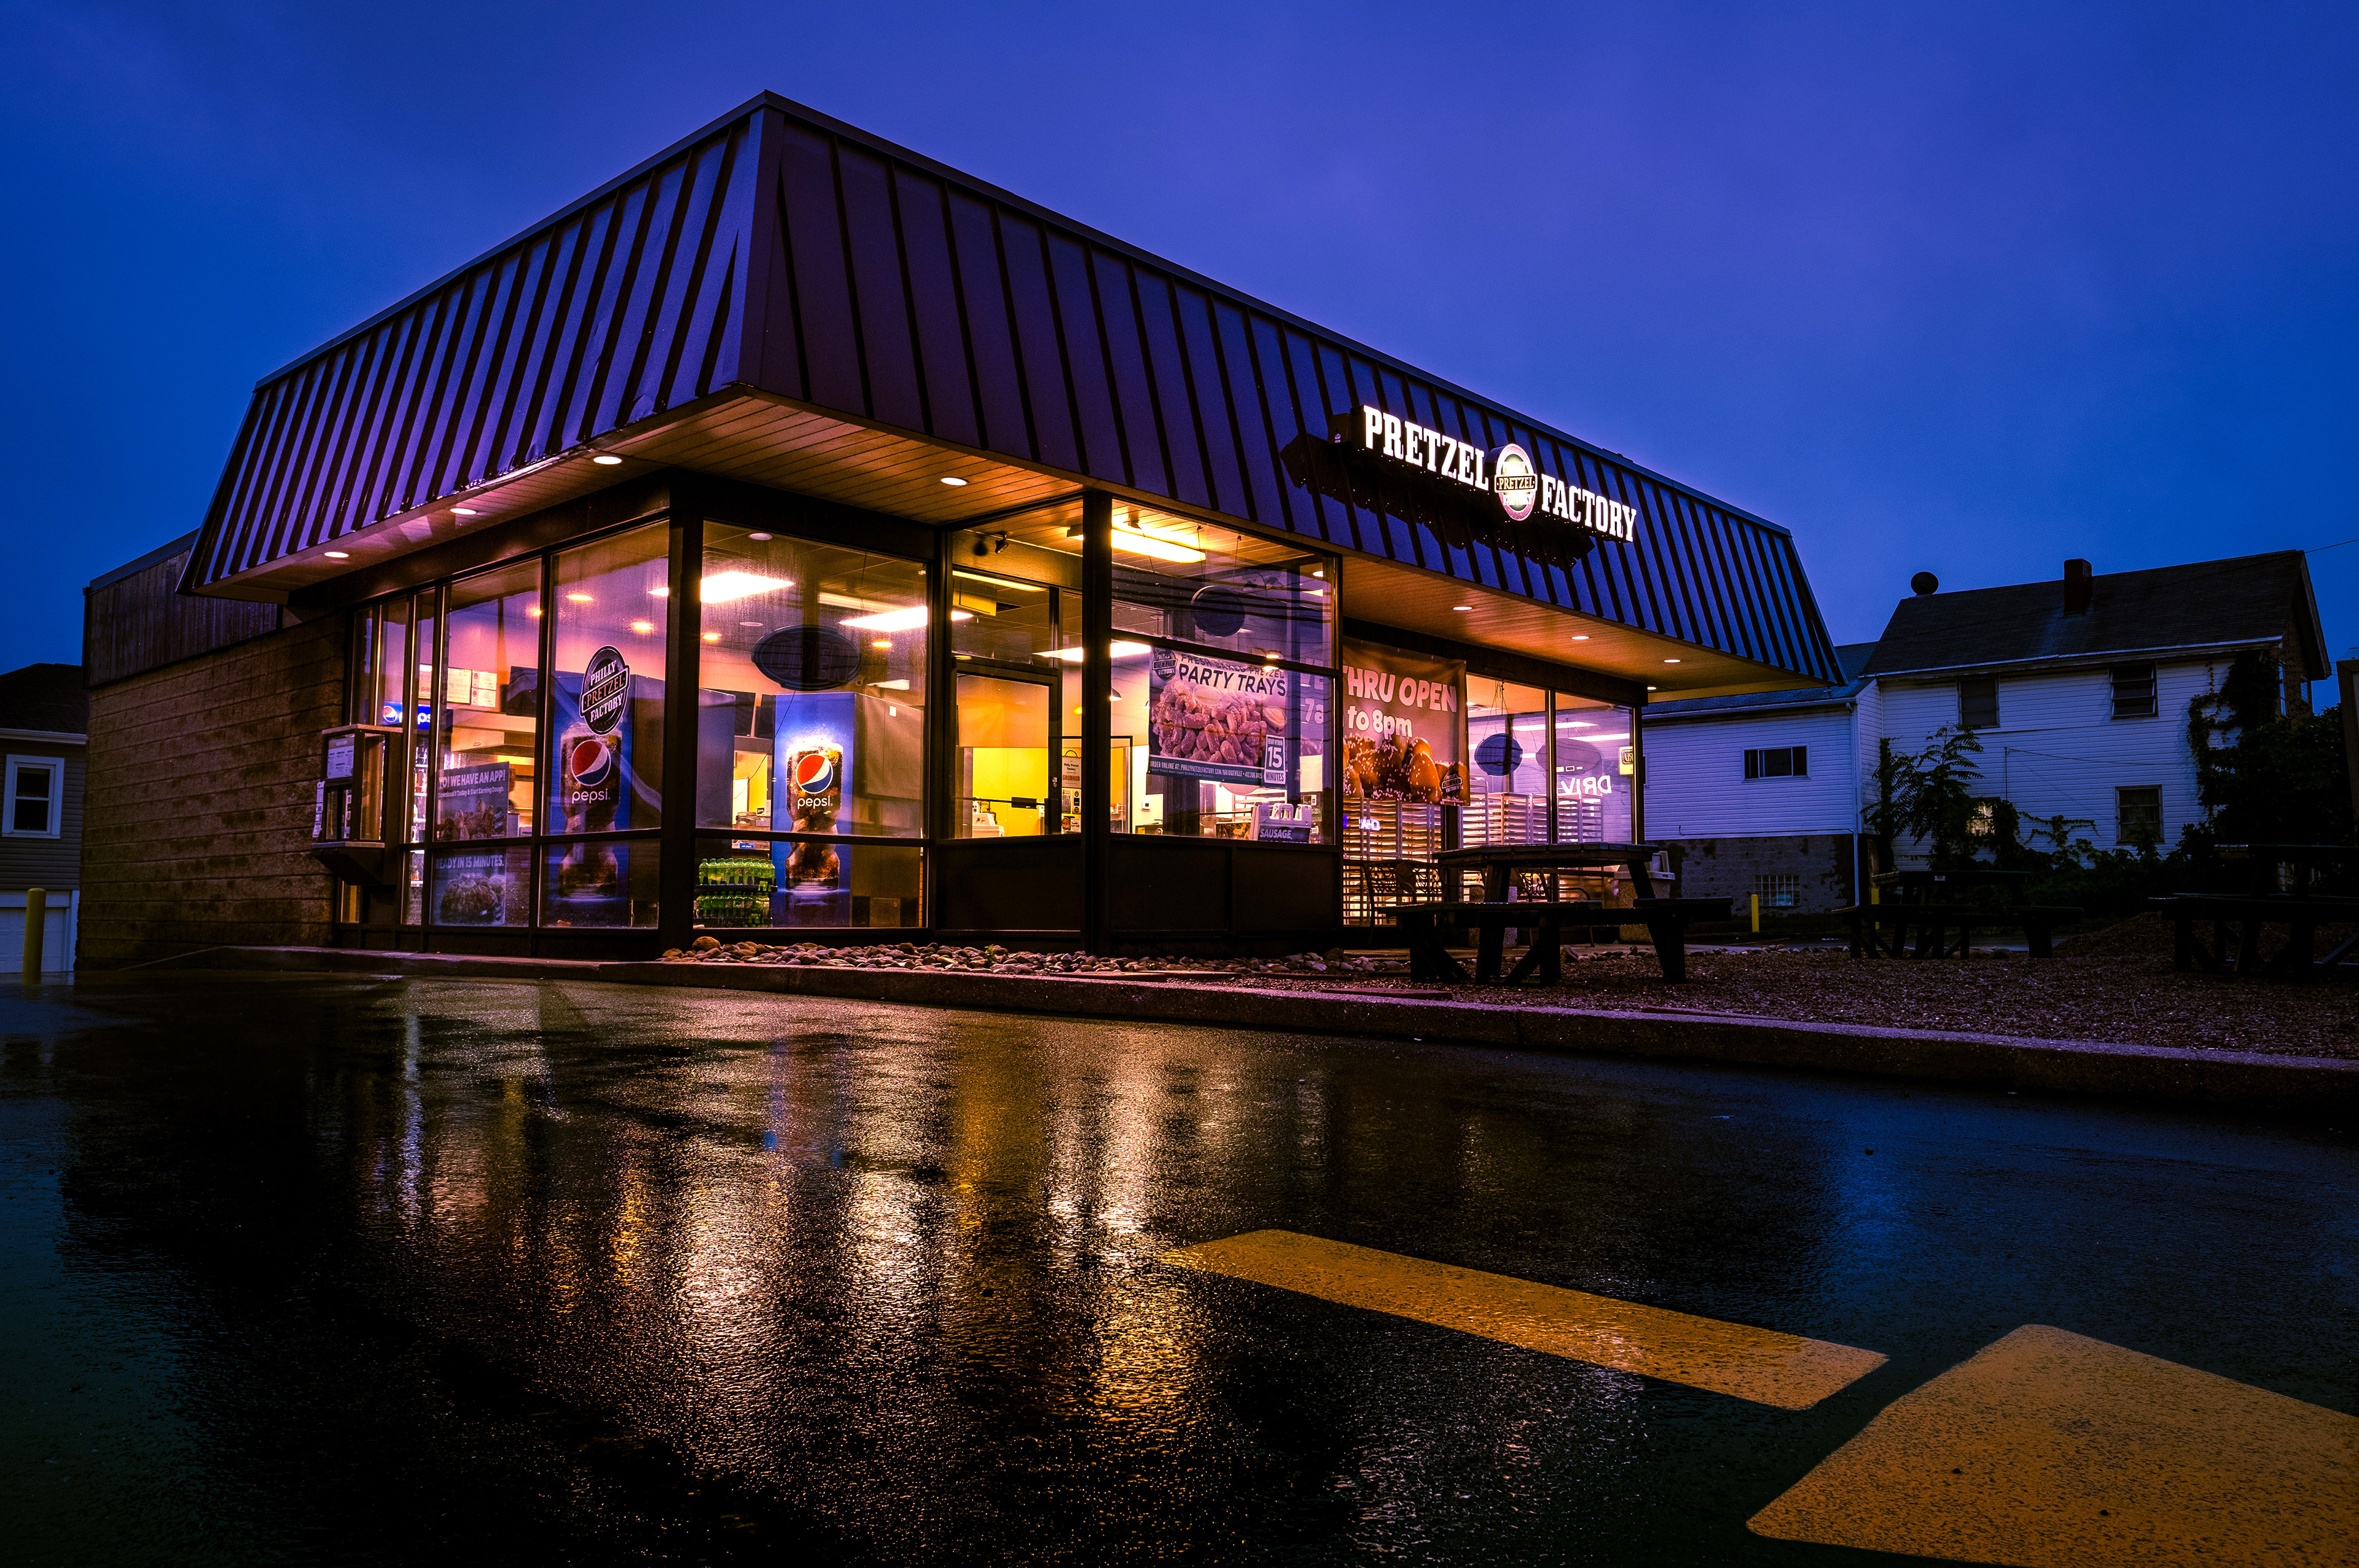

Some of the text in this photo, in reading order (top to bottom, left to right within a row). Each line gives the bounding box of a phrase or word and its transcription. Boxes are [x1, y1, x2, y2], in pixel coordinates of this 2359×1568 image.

[1364, 405, 1637, 542] PRETZEL FACTORY
[1499, 477, 1534, 490] PRETZEL
[590, 660, 617, 686] PHILLY
[1181, 653, 1211, 667] FRESH
[1215, 660, 1246, 673] BAKED
[1250, 667, 1285, 679] PRETZEL
[586, 674, 624, 708] PRETZEL
[1178, 663, 1235, 689] PARTY
[1237, 674, 1286, 696] TRAYS
[1399, 677, 1457, 713] OPEN
[590, 693, 624, 723] FACTORY
[1347, 706, 1369, 731] to
[1372, 709, 1412, 739] 8pm
[1268, 746, 1283, 768] 15
[439, 770, 506, 788] YO! WE HAVE AN APP!
[1266, 771, 1285, 782] MINUTES
[572, 788, 608, 804] pepsi
[797, 795, 831, 809] pepsi
[1259, 829, 1293, 840] SAUSAGE,
[436, 854, 504, 869] READY IN 15 MINUTES.
